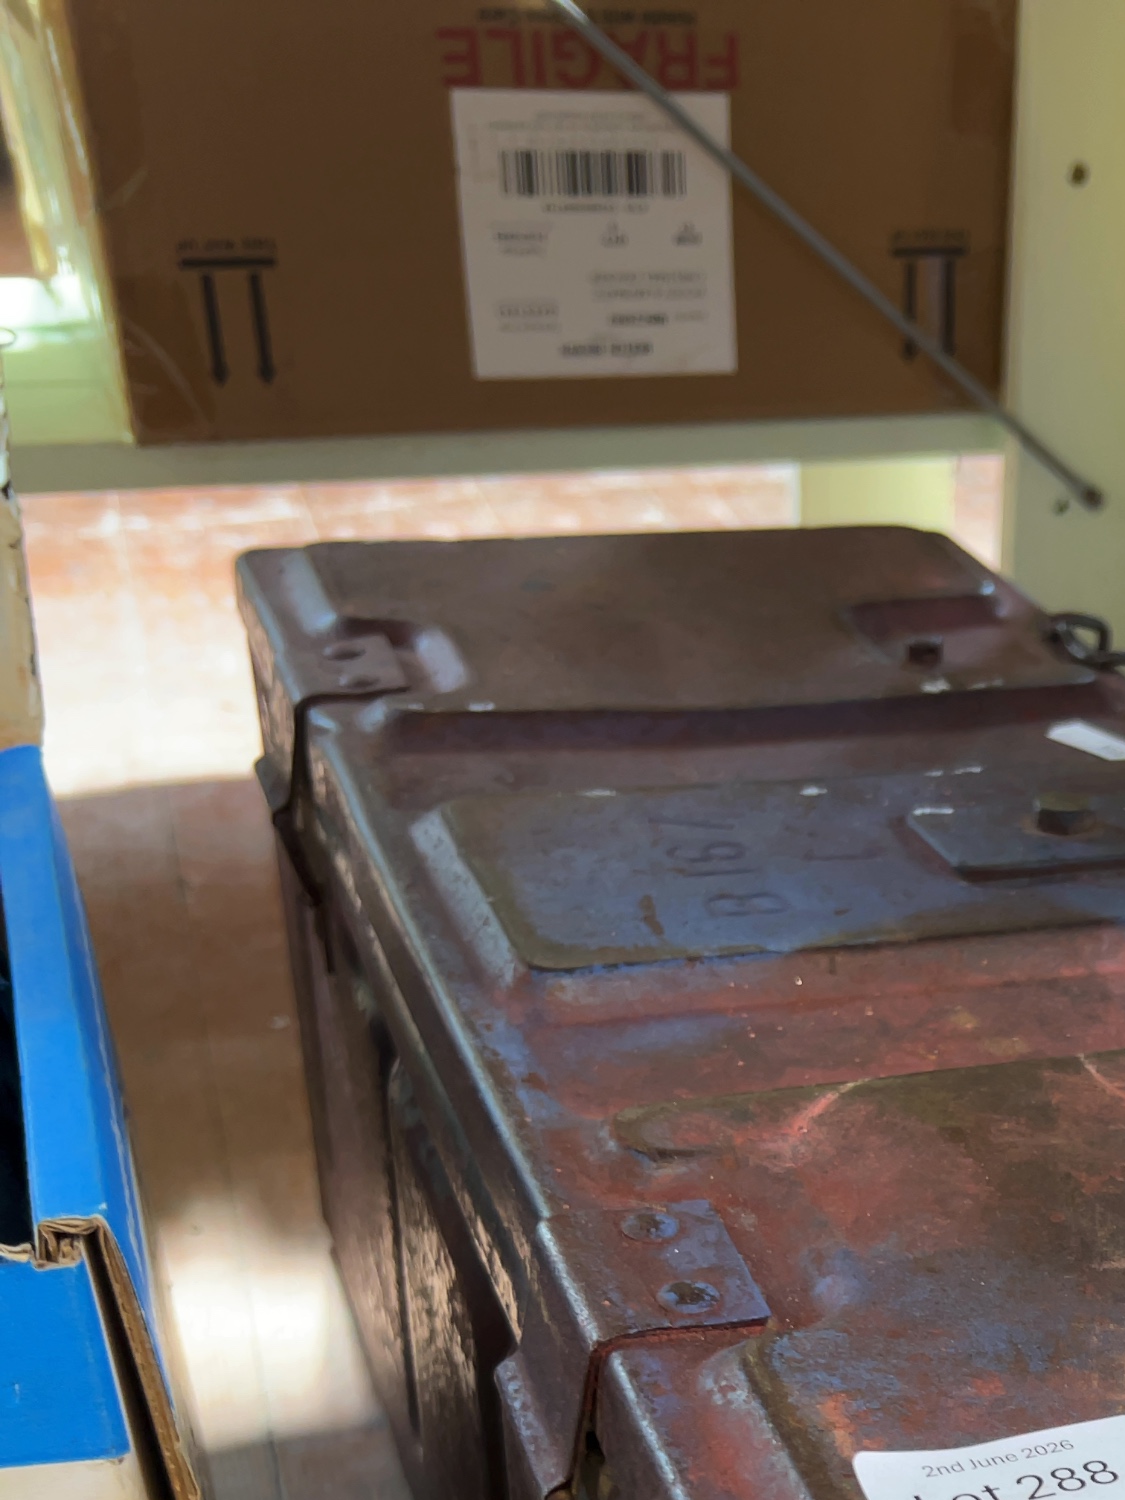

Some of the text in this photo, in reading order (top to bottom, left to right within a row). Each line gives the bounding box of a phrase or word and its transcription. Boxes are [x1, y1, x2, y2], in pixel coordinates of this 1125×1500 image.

[435, 27, 740, 89] FRAGILE
[921, 1439, 1075, 1478] 2nd June 2026
[1015, 1460, 1120, 1500] 288
